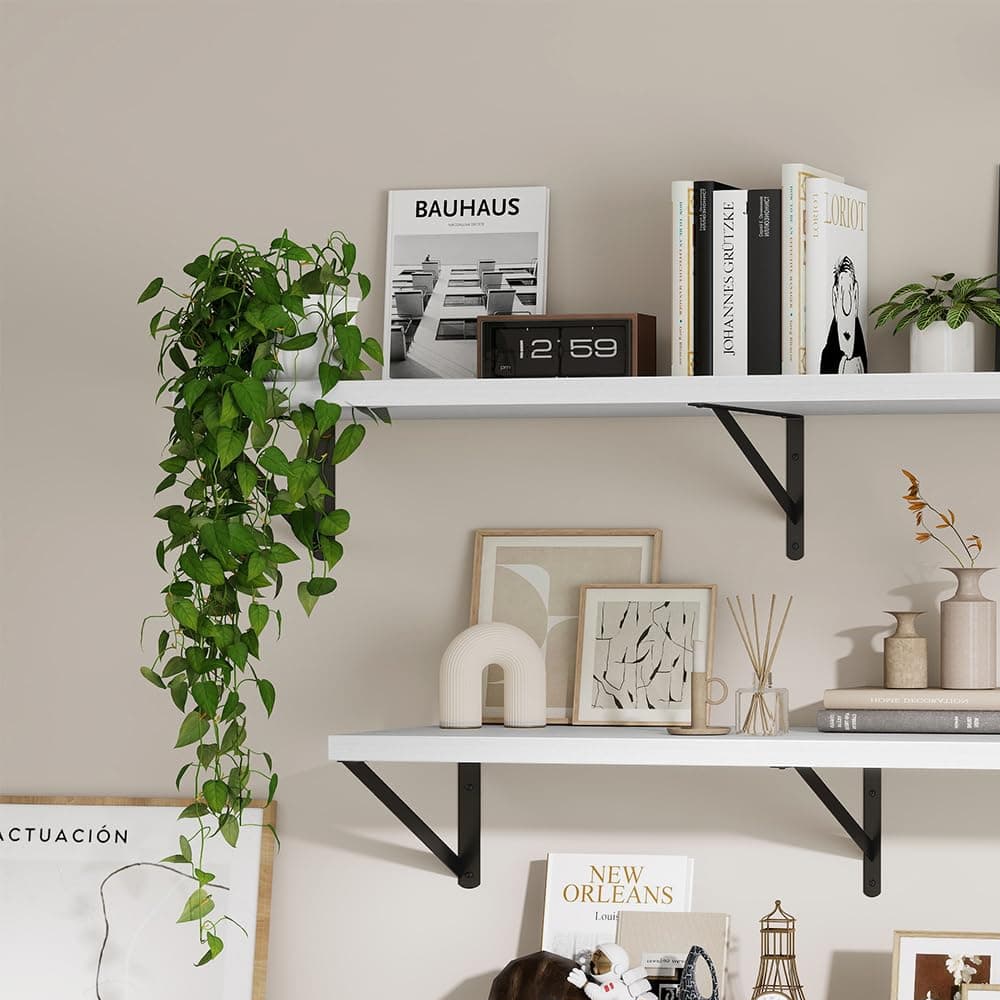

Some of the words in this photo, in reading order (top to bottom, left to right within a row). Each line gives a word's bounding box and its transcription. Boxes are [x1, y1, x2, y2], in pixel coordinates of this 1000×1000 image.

[415, 198, 520, 218] BAUHAUS
[823, 191, 867, 232] LORIOT
[722, 201, 735, 272] GRÜTZKE
[722, 274, 736, 356] JOHANNES
[519, 339, 553, 359] 12
[569, 338, 618, 359] 59
[590, 865, 644, 884] NEW
[562, 883, 674, 905] ORLEANS
